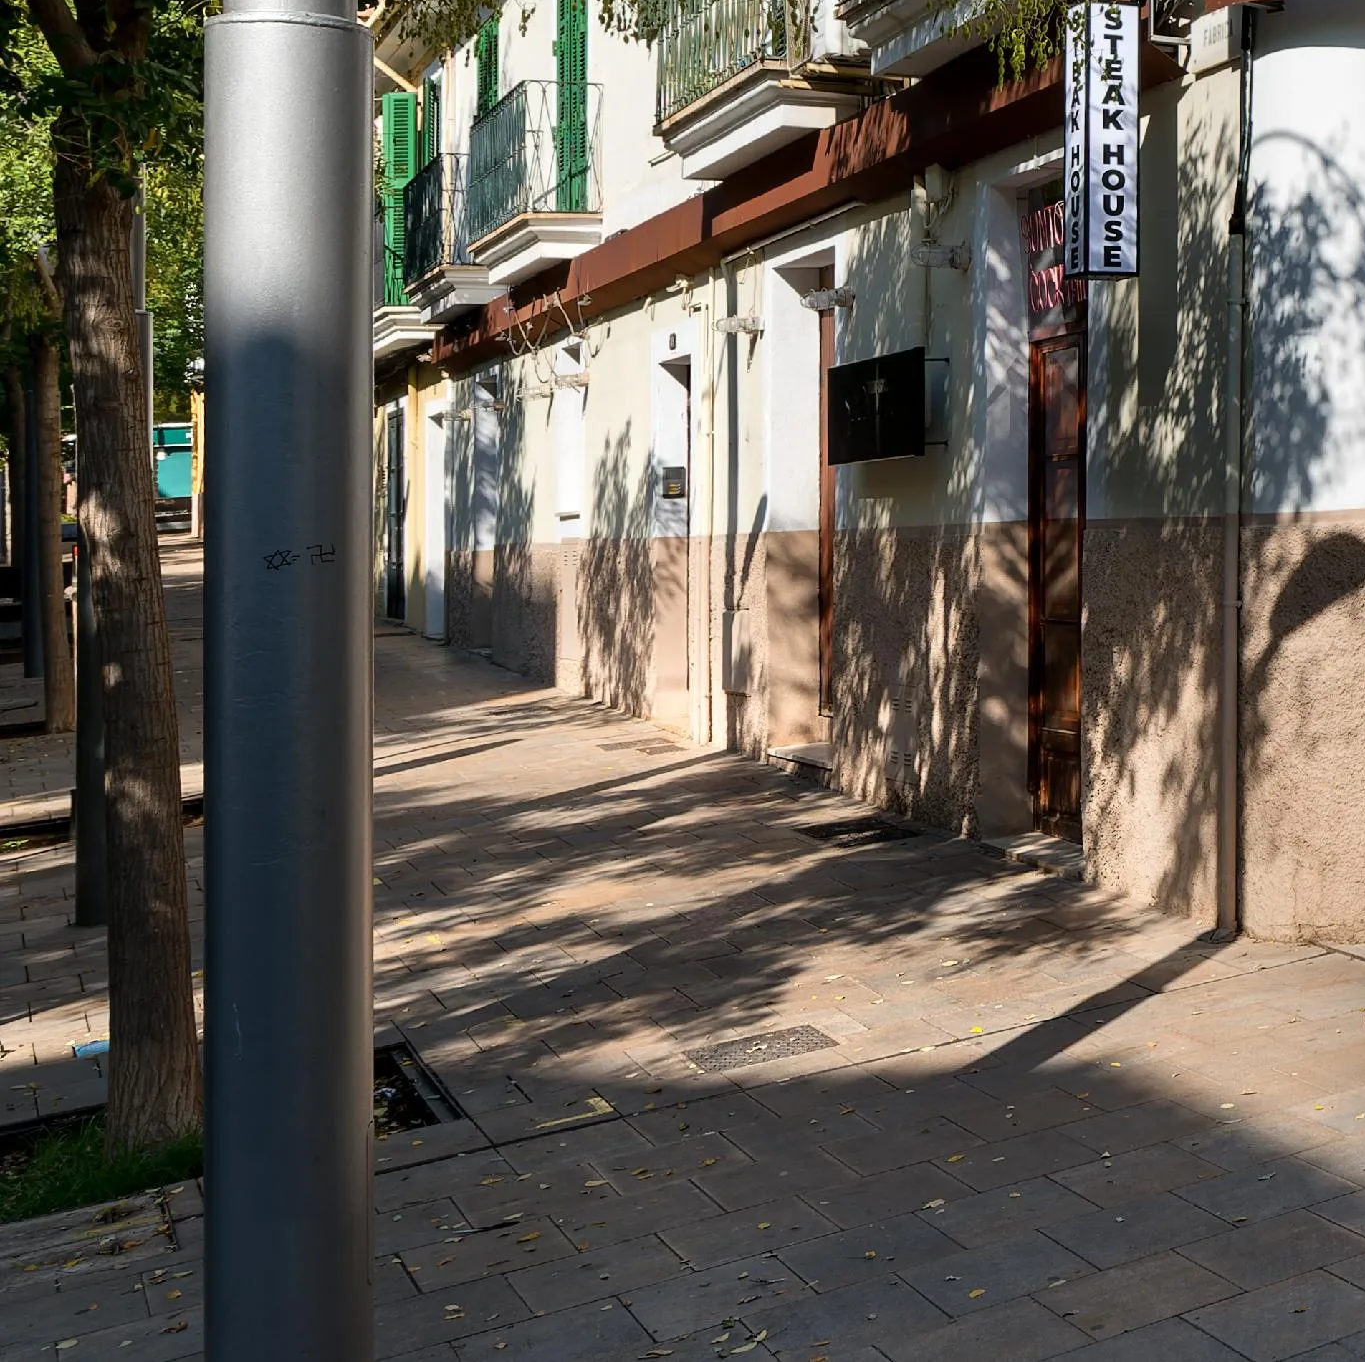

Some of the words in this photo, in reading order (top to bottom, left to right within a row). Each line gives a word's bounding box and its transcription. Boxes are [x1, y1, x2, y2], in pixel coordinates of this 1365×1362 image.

[1101, 8, 1126, 131] STEAK
[1071, 144, 1080, 269] HOUSE
[1101, 143, 1126, 268] HOUSE
